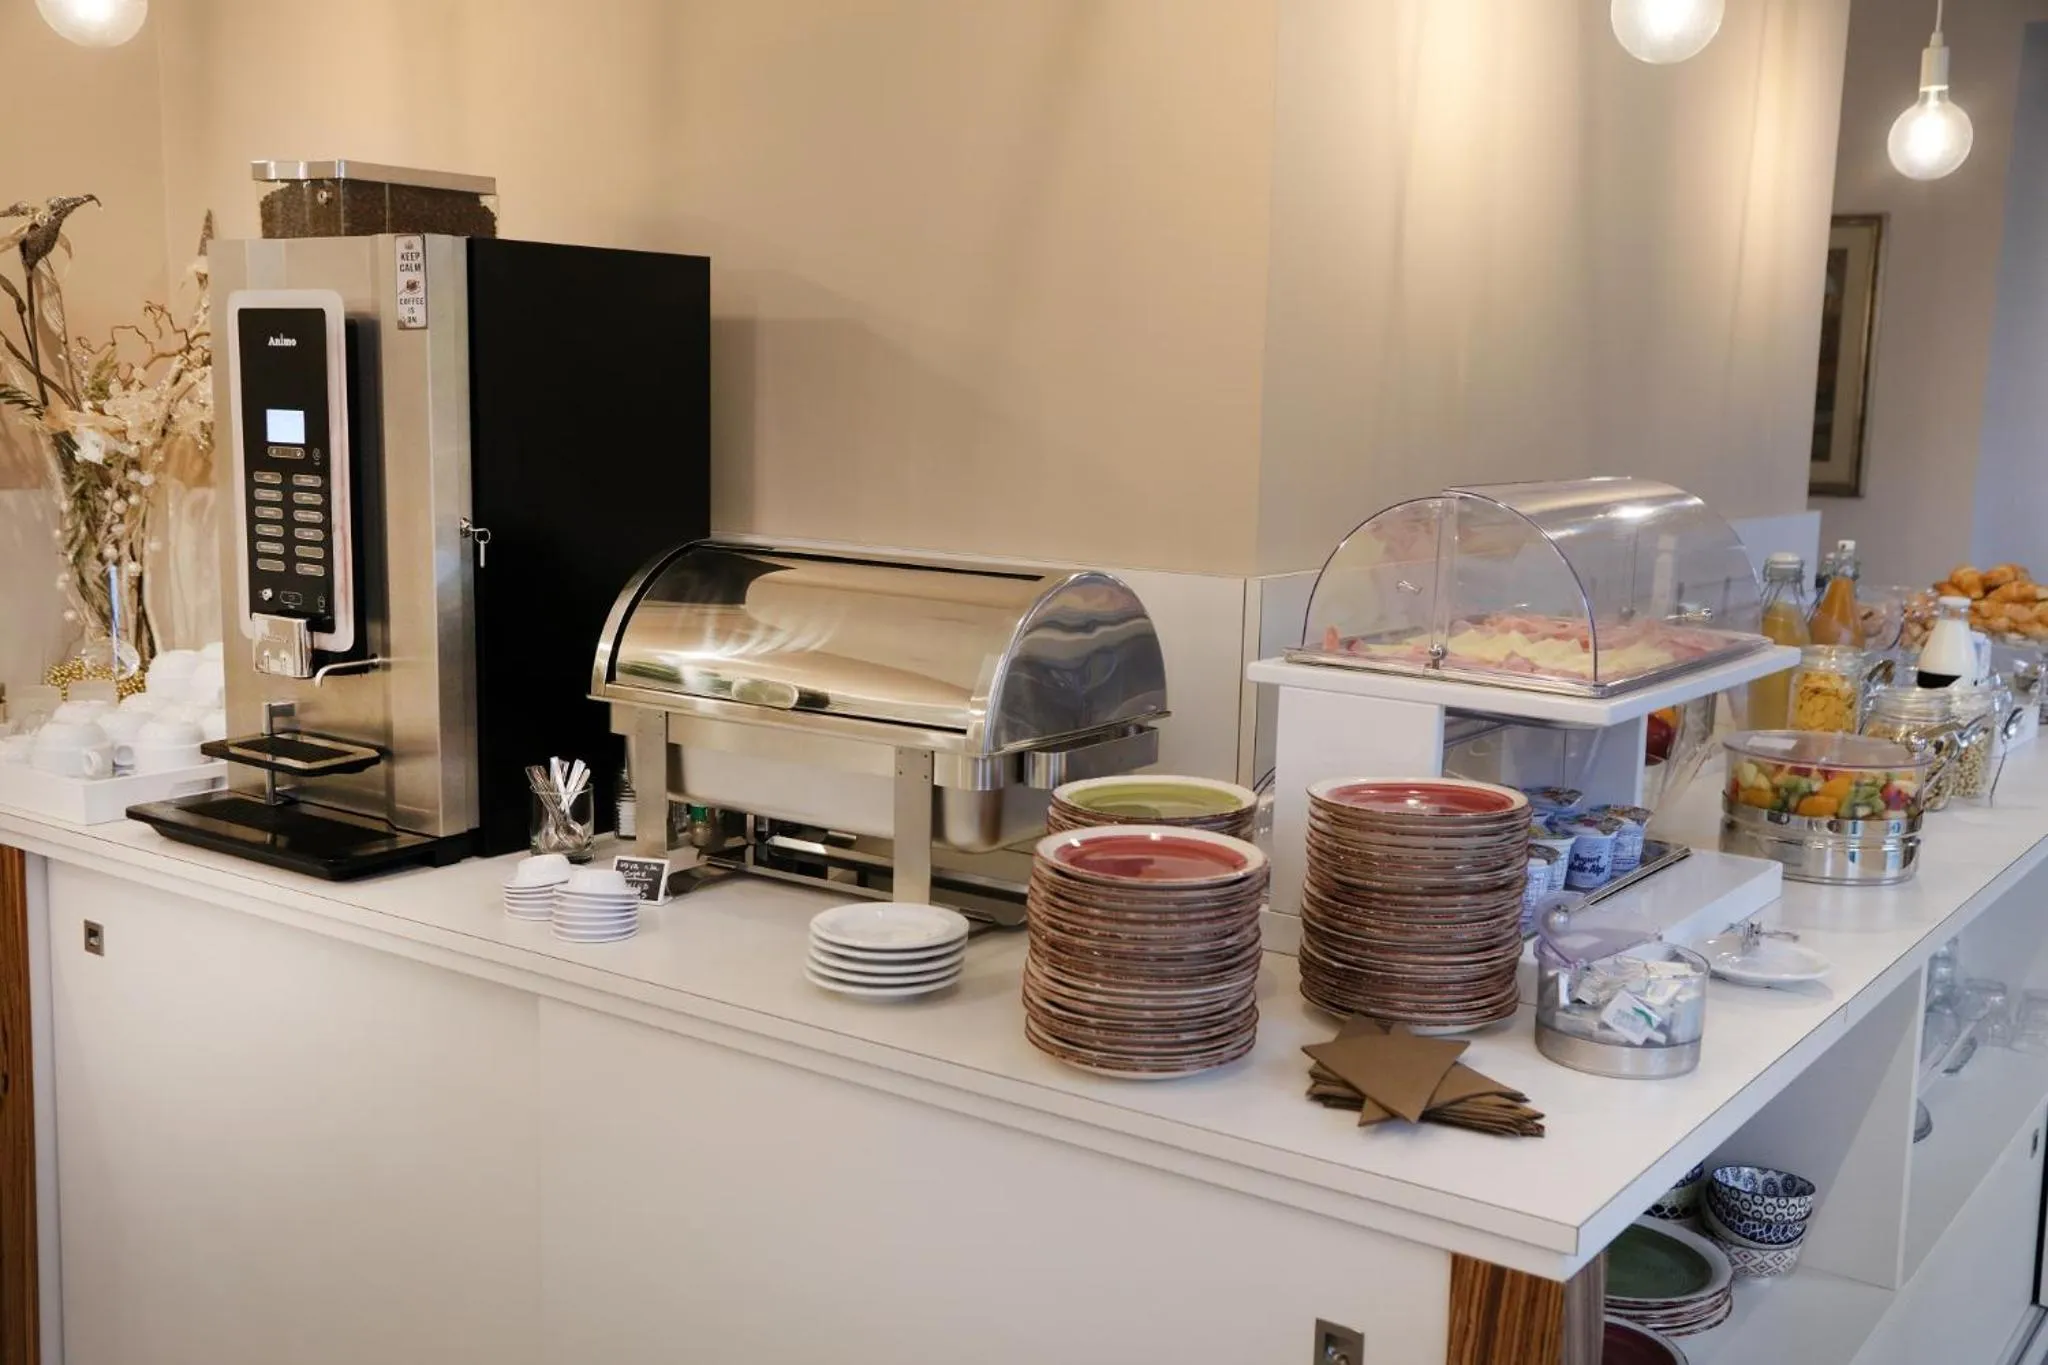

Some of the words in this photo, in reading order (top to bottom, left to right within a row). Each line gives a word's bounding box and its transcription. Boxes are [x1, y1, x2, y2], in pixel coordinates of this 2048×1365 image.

[401, 252, 420, 261] KEEP
[400, 263, 421, 272] CALM
[400, 297, 424, 305] COFFEE
[268, 333, 297, 346] Animo
